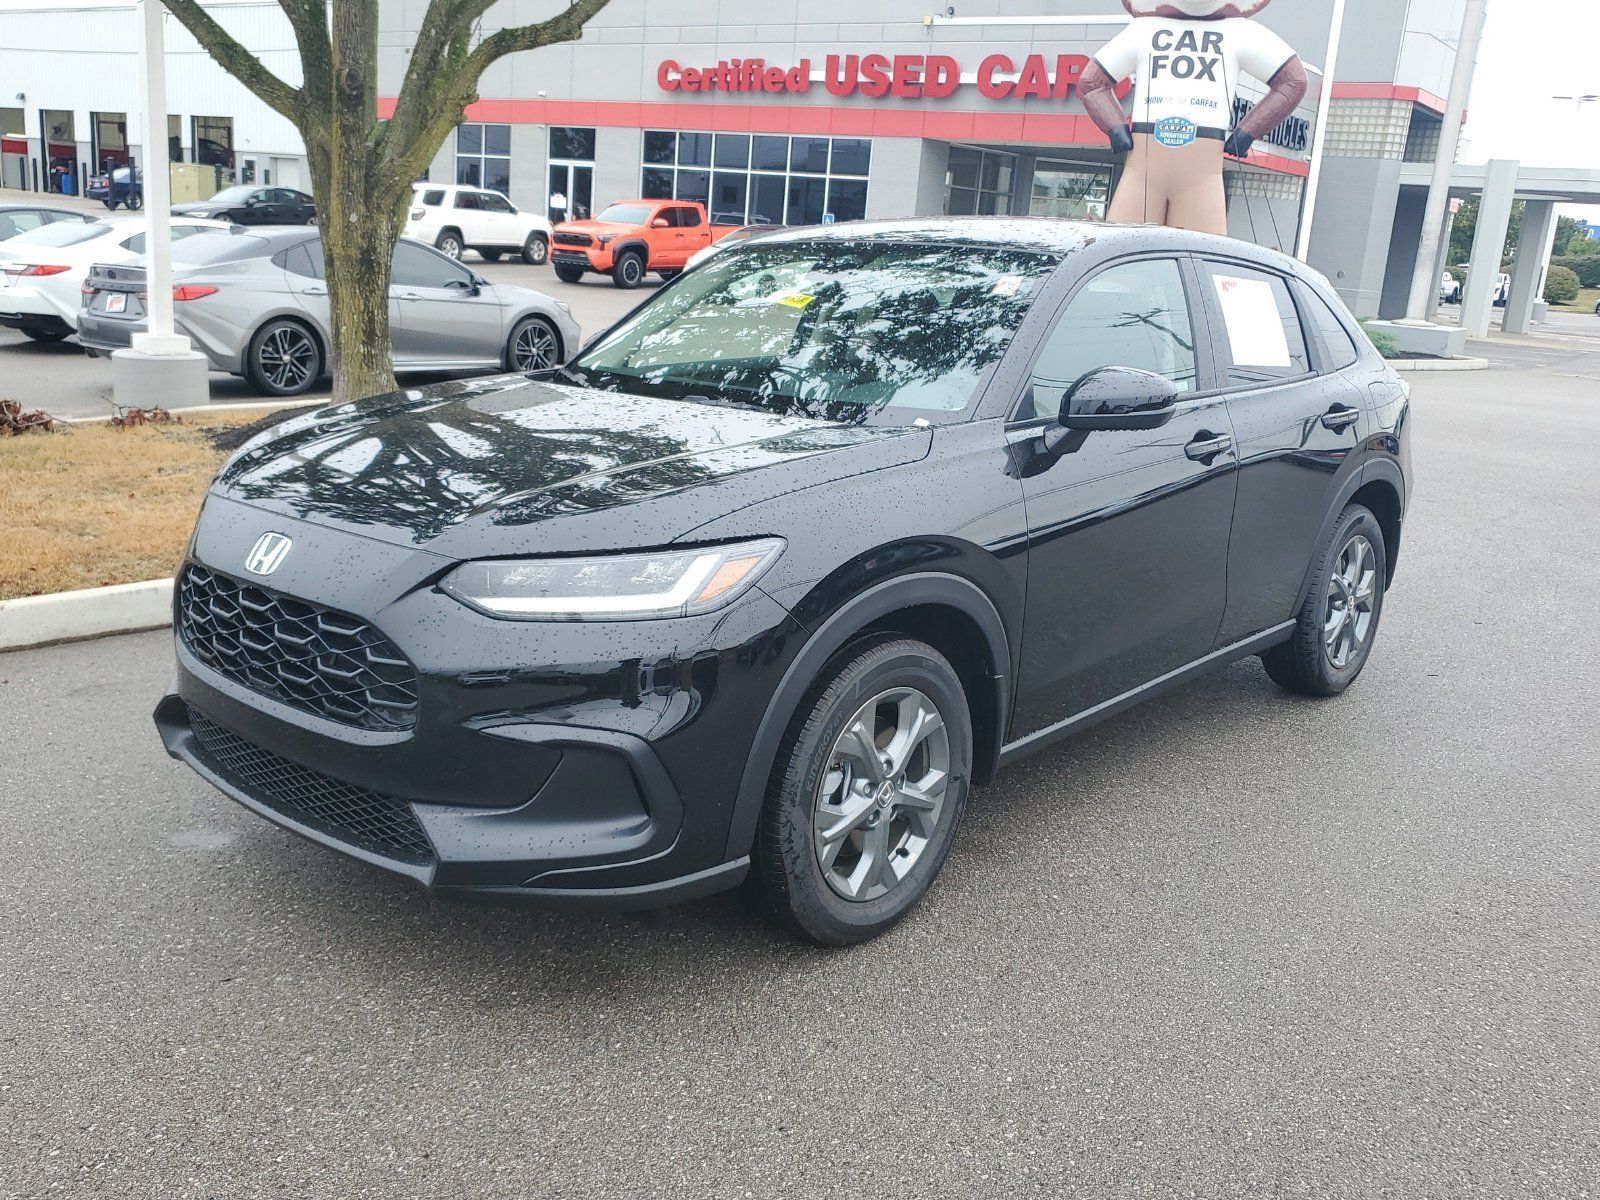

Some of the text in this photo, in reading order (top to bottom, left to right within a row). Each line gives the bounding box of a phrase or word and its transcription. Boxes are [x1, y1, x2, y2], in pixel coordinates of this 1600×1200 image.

[1151, 29, 1224, 54] CAR
[657, 53, 1132, 100] Certified USED CAR
[1151, 55, 1219, 82] FOX
[1144, 96, 1164, 105] SHOW
[1190, 97, 1218, 109] CARFAX
[1159, 131, 1192, 140] ADVANTAGE
